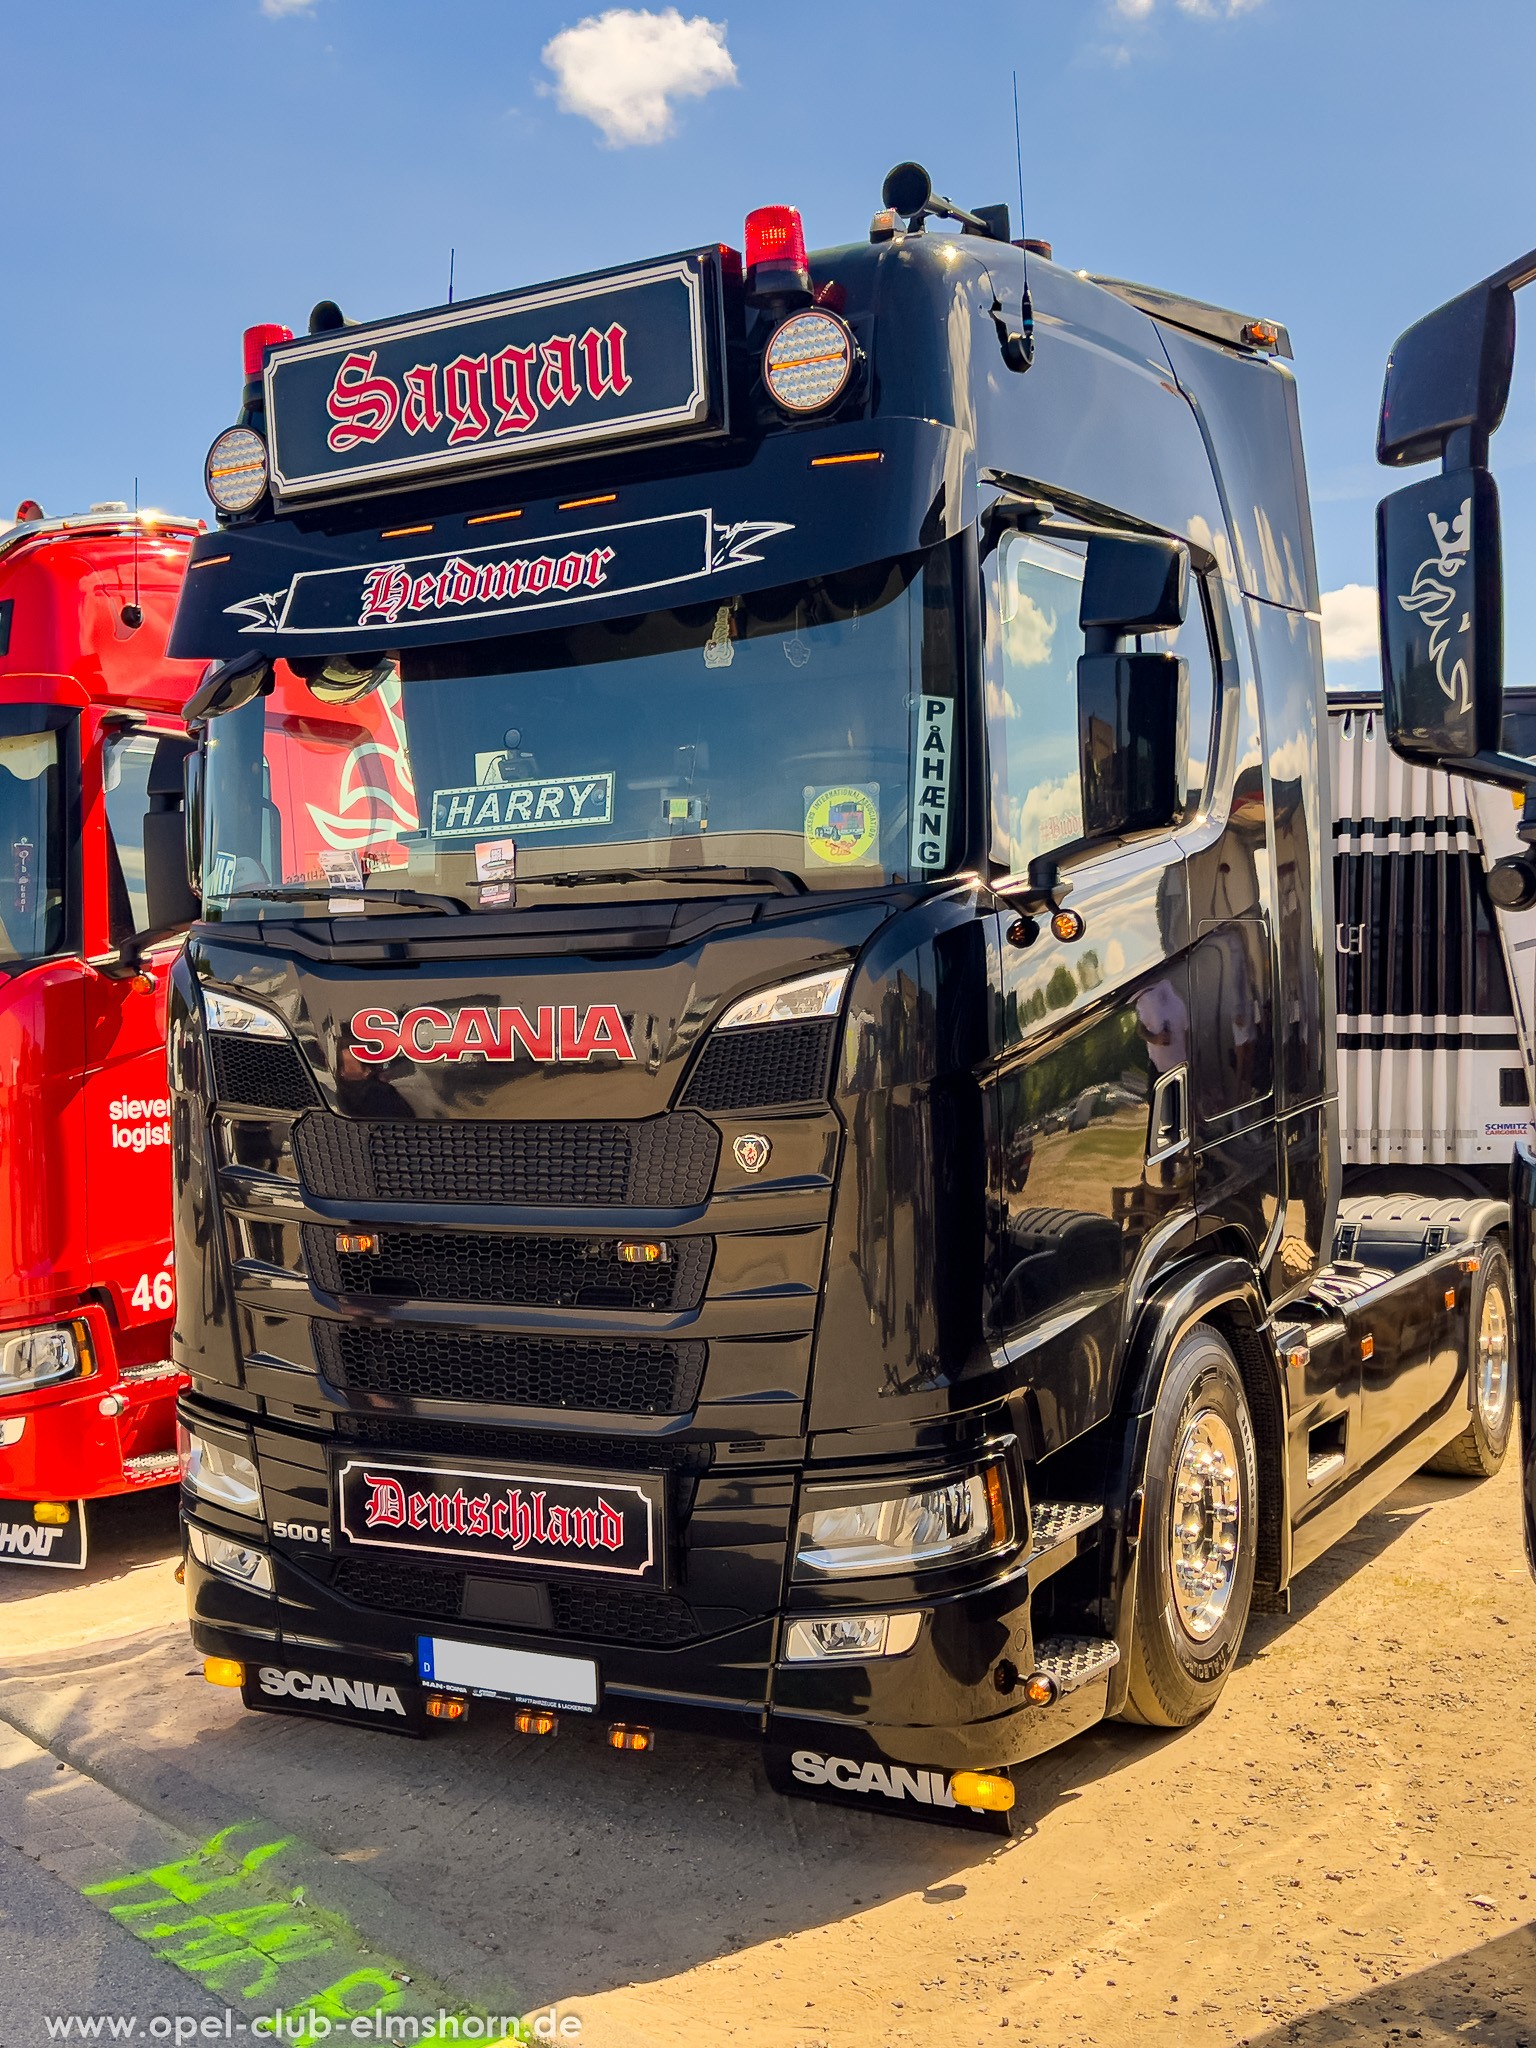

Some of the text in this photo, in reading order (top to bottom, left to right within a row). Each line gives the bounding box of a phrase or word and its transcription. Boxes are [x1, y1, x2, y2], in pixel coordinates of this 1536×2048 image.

[326, 321, 633, 453] Saggau
[358, 545, 615, 626] Heidmoor
[445, 783, 597, 828] HARRY
[812, 788, 861, 811] INTERNATIONAL
[917, 700, 946, 864] PÅHÆNG
[349, 1004, 637, 1062] SCANIA
[1484, 1123, 1528, 1131] SCHMITZ
[272, 1521, 318, 1543] 500
[363, 1473, 624, 1551] Deutschland
[0, 1522, 64, 1557] HOLT
[258, 1667, 407, 1716] SCANIA
[423, 1662, 431, 1673] D
[791, 1751, 985, 1814] SCANI
